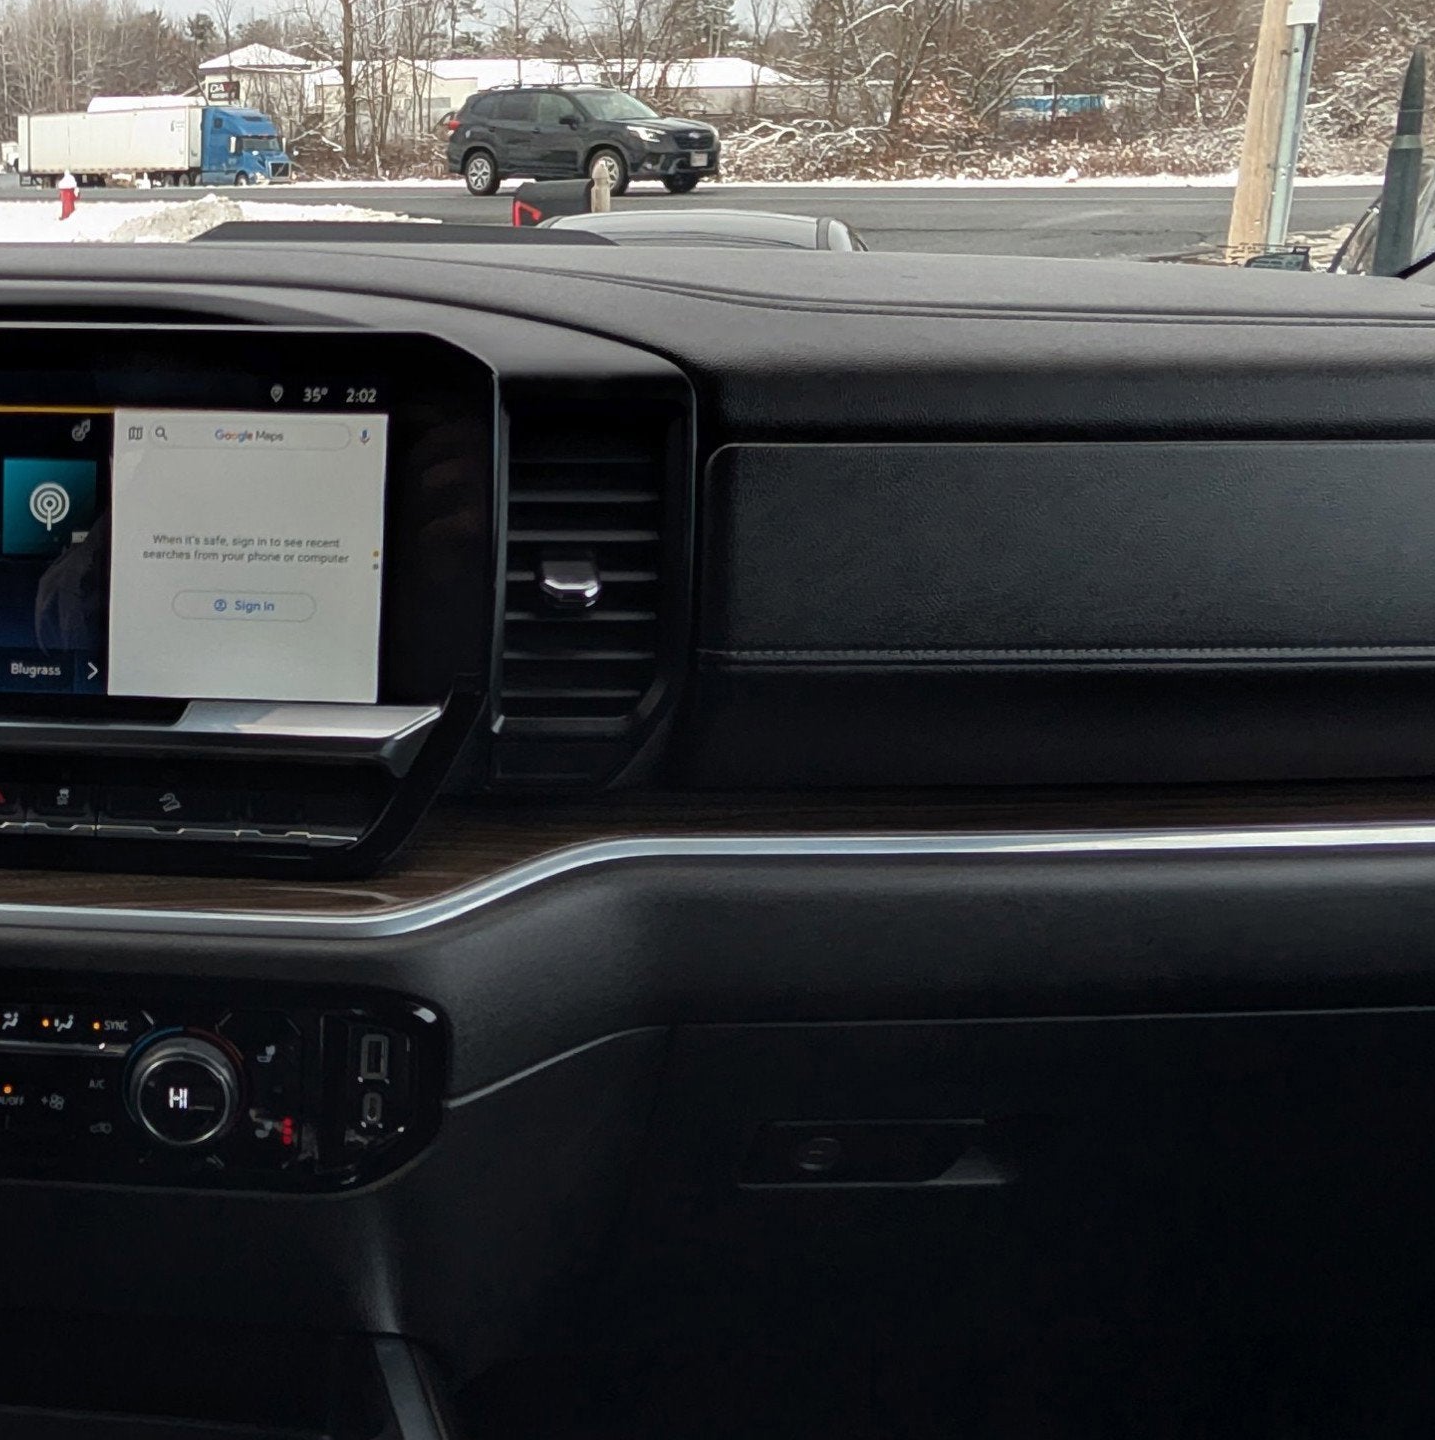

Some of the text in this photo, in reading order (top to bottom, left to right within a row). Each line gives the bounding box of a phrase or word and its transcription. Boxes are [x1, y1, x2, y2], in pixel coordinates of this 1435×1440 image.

[346, 388, 377, 403] 2:02
[214, 429, 284, 443] Google Maps
[152, 534, 340, 549] When it's safe, sign in to see recent
[143, 549, 349, 565] searches from your phone or computer
[234, 600, 260, 614] Sign
[10, 662, 62, 678] Blugrass
[103, 1020, 129, 1032] SYNC
[88, 1078, 105, 1091] A/C
[168, 1086, 188, 1110] HI
